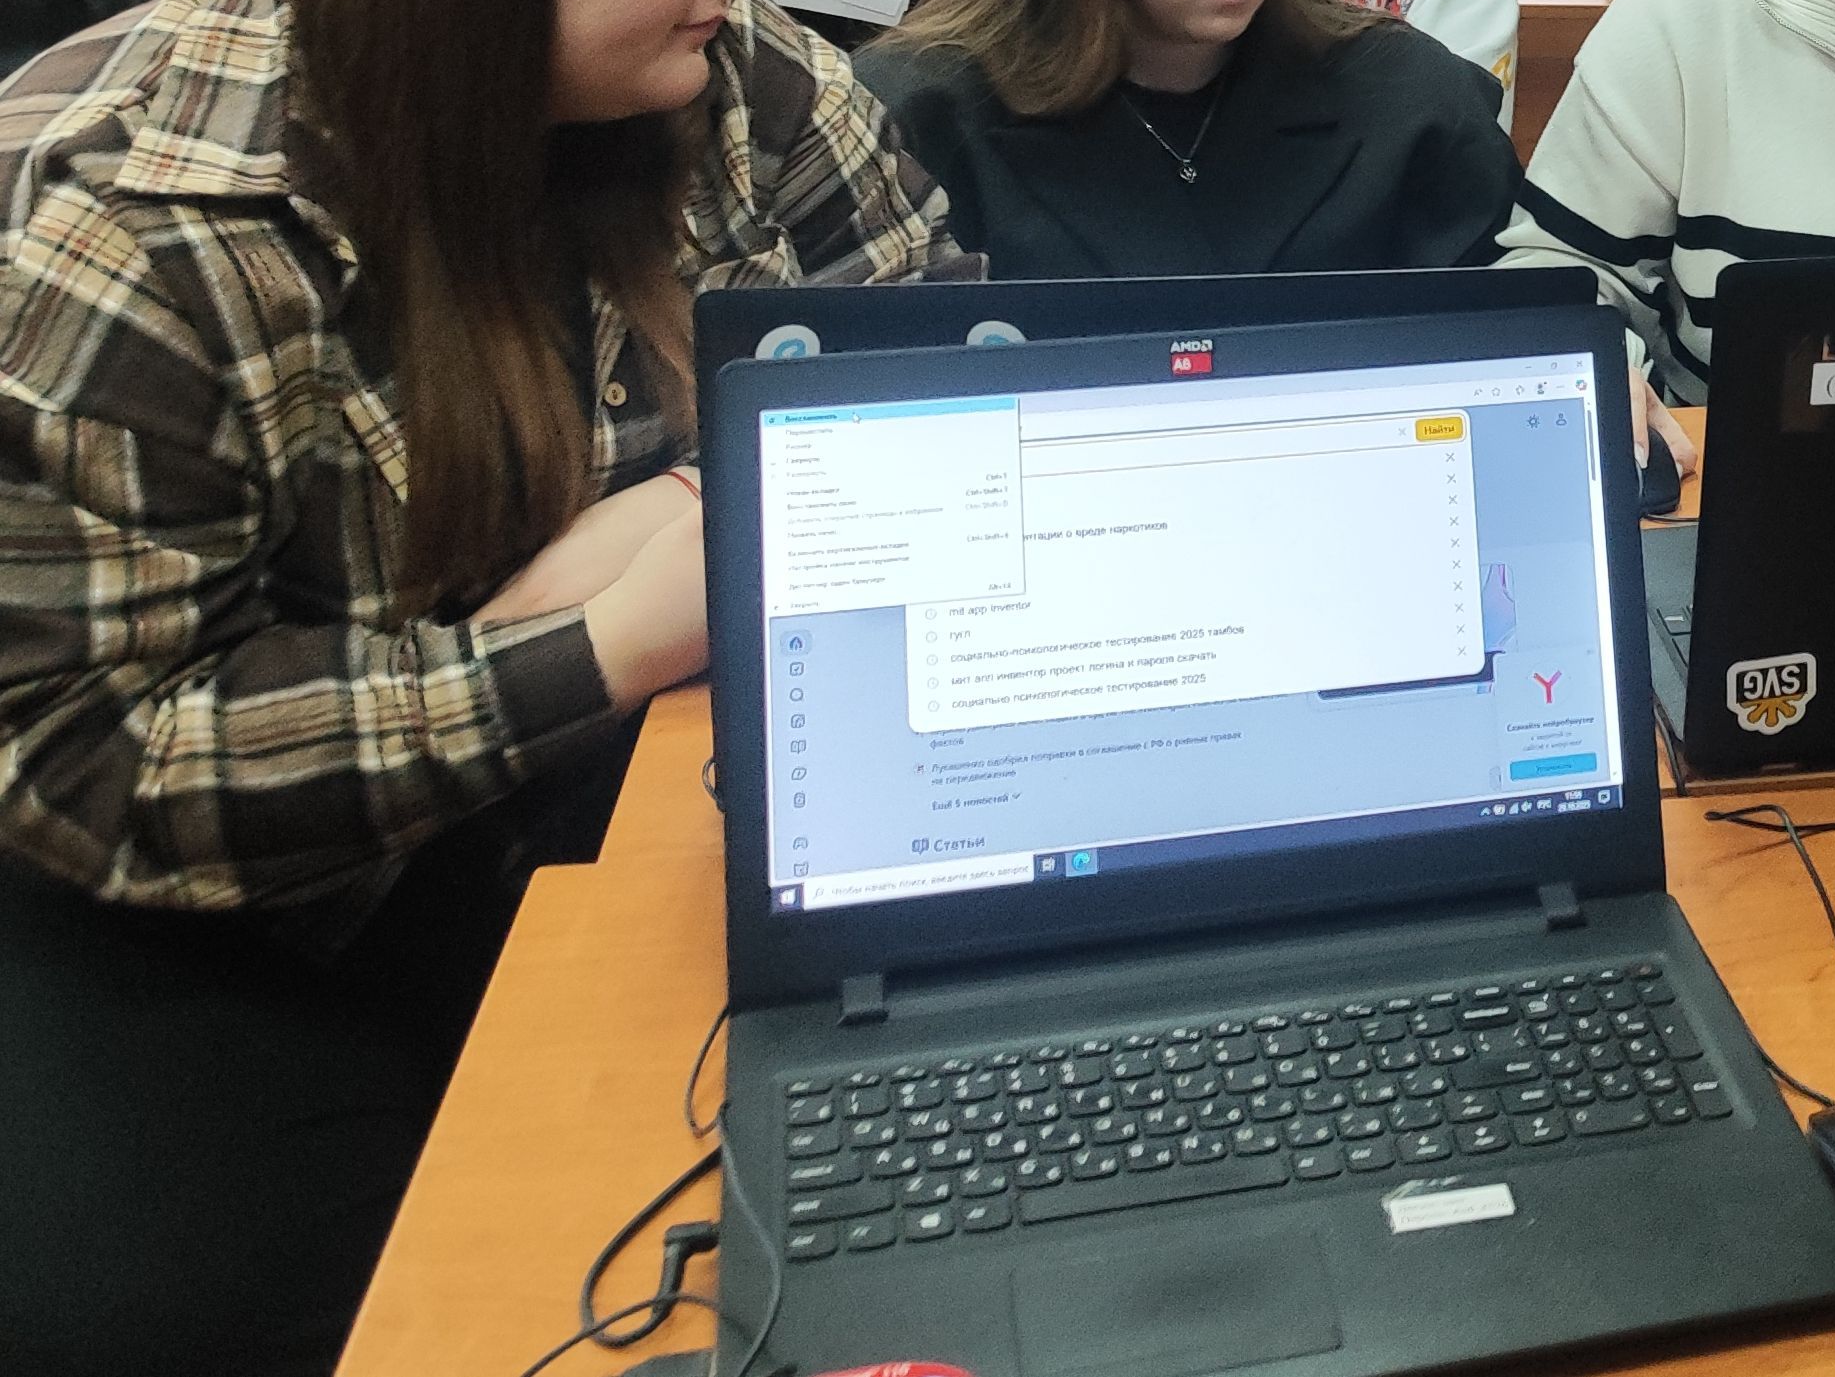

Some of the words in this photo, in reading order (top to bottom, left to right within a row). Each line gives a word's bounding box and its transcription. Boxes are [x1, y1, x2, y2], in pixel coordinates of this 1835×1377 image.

[1170, 340, 1201, 353] AMD
[1423, 422, 1456, 436] Найти
[1075, 526, 1106, 538] вреде
[1109, 520, 1167, 535] наркотиков
[967, 604, 987, 616] app
[1104, 630, 1176, 649] тестирование
[1179, 628, 1204, 640] 2025
[1207, 623, 1244, 637] тамбов
[1049, 663, 1085, 677] проект
[1088, 659, 1124, 672] логина
[1176, 650, 1216, 663] скачать
[951, 694, 1010, 711] социально
[1105, 676, 1178, 695] тестирование
[1180, 672, 1206, 685] 2025
[1742, 668, 1802, 700] SVG
[933, 832, 985, 854] Статьи
